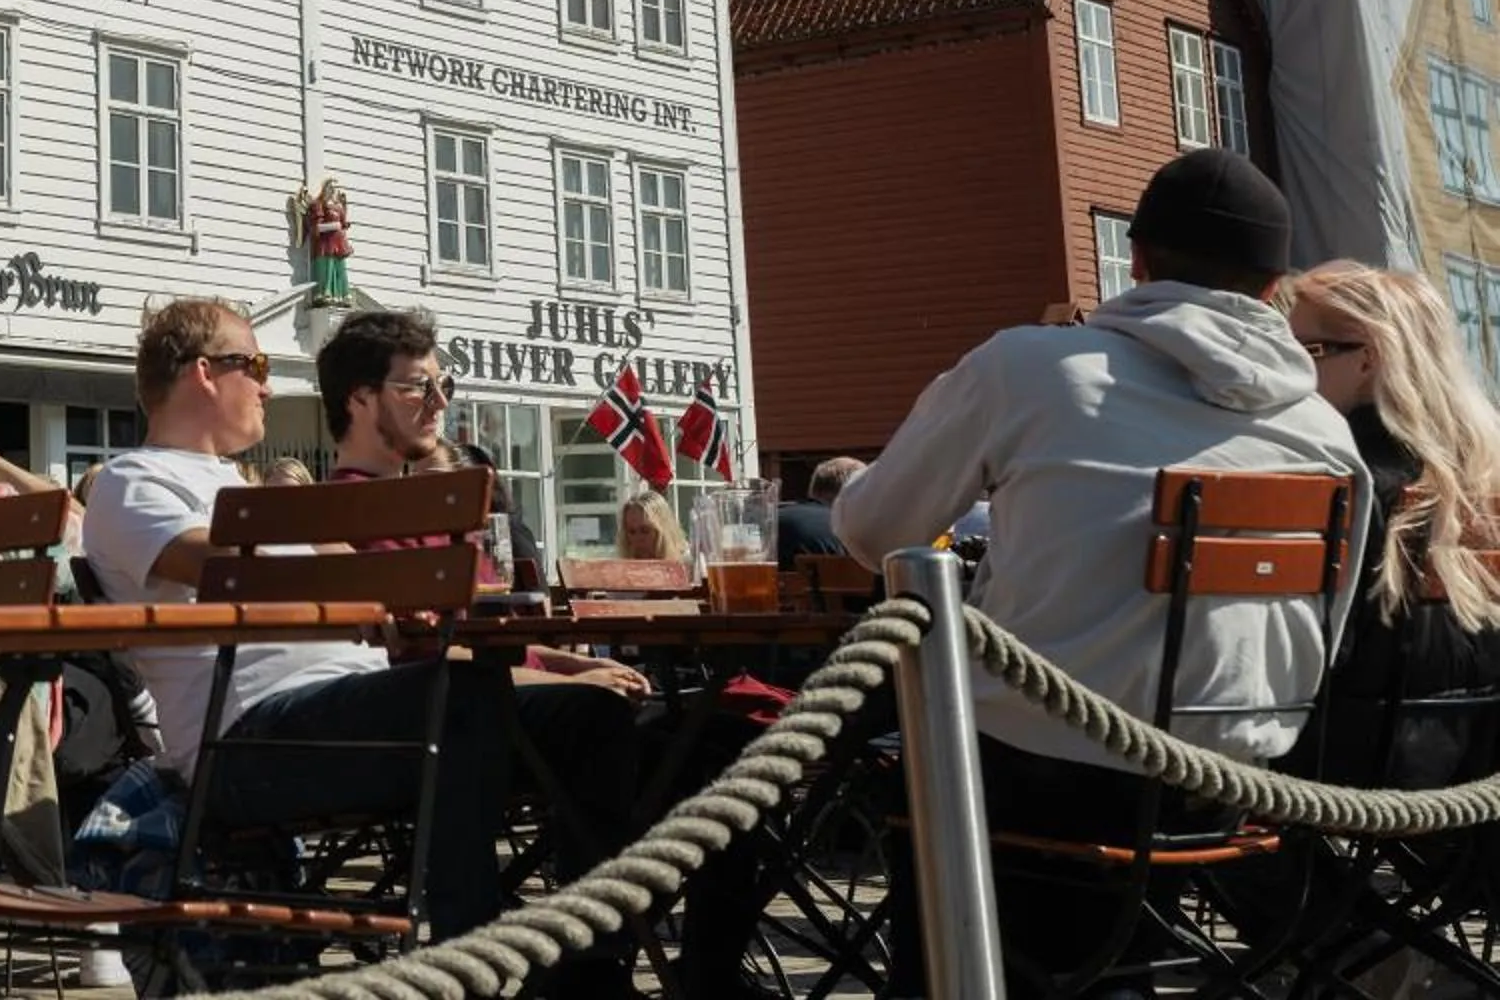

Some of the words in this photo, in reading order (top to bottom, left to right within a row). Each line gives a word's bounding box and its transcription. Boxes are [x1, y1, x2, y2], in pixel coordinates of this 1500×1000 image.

[351, 36, 486, 91] NETWORK
[491, 67, 648, 122] CHARTERING
[653, 101, 697, 133] INT.
[450, 336, 576, 387] SILVER
[594, 352, 732, 400] GLLERY
